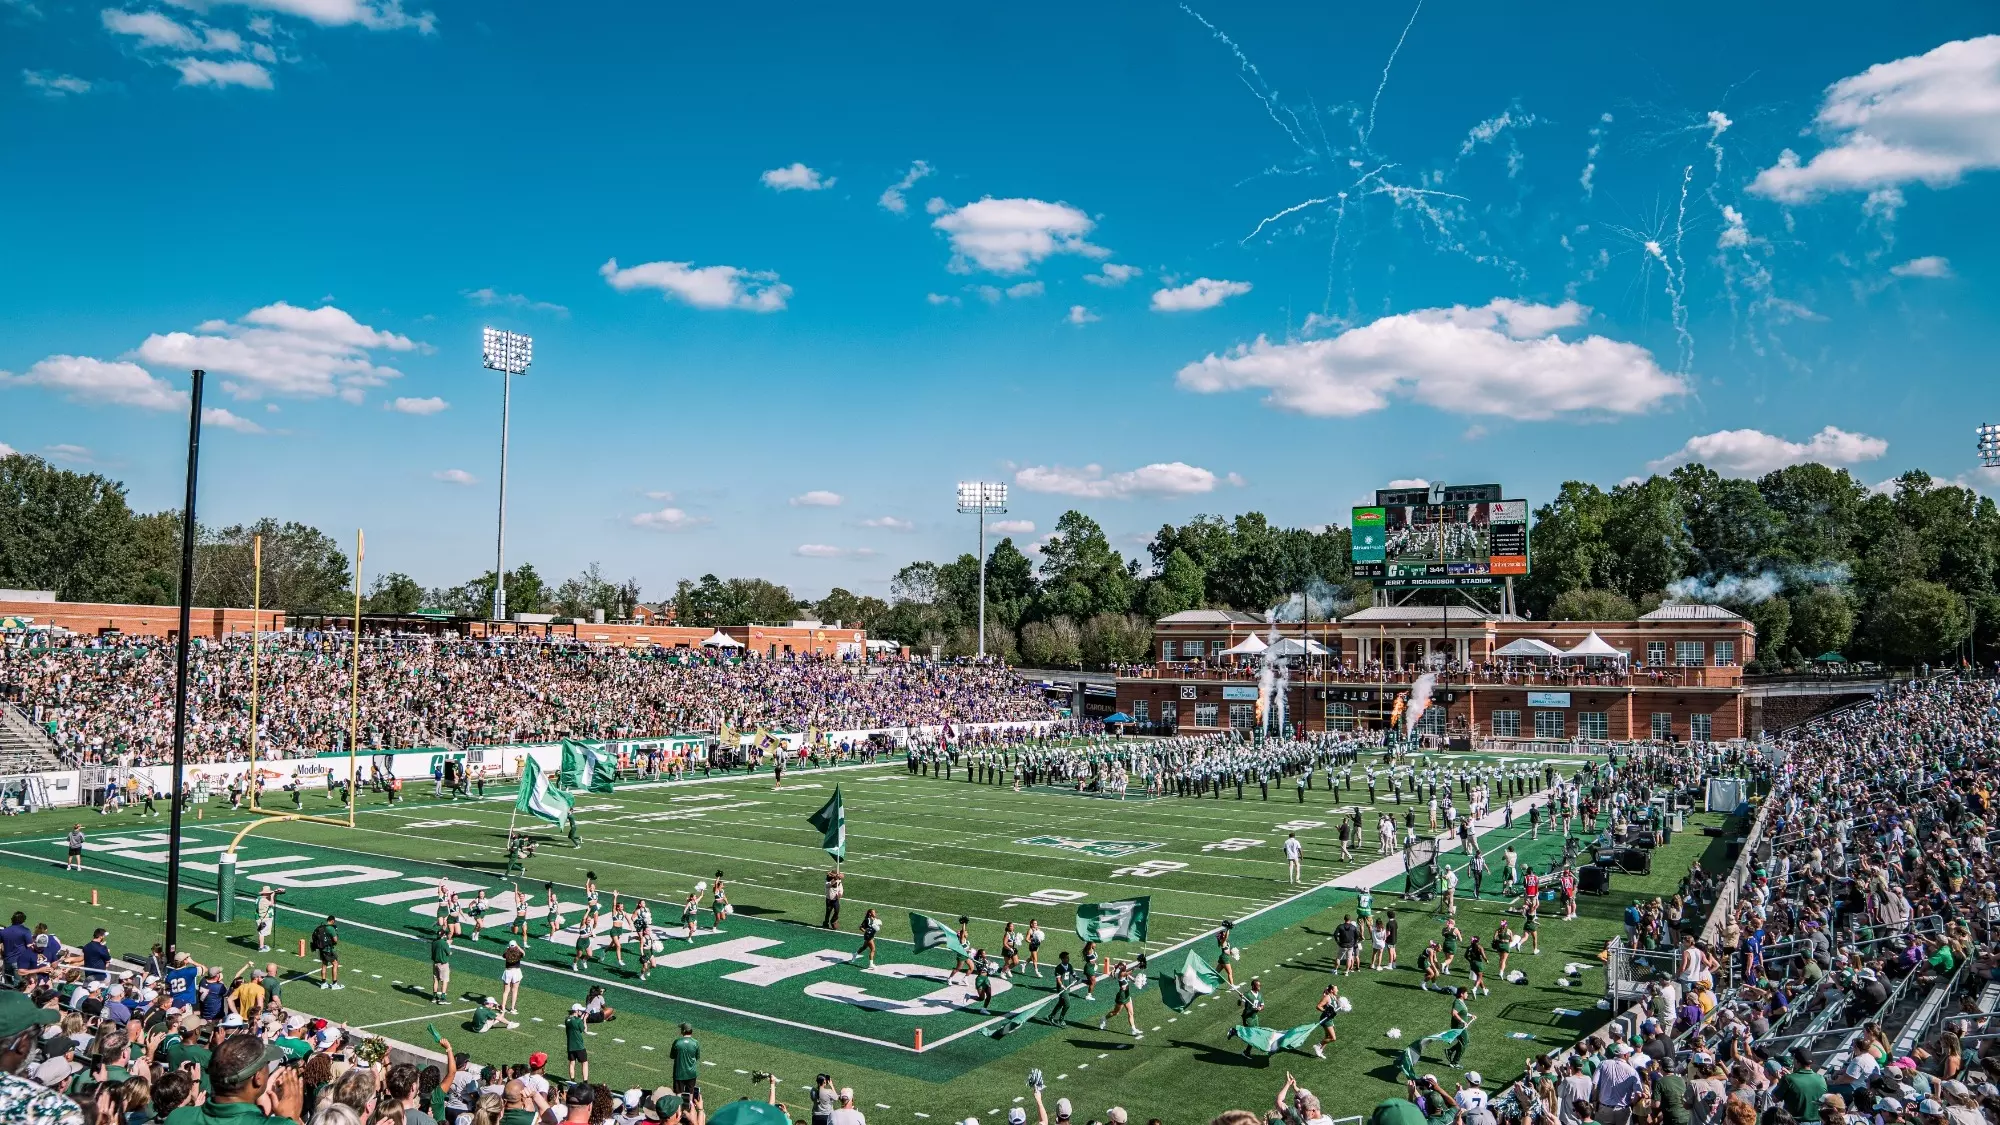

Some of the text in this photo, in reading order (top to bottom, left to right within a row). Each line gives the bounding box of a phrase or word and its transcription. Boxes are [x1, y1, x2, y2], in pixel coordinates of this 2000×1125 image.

[1183, 687, 1194, 698] 25
[297, 763, 324, 774] Modelo
[1110, 859, 1190, 877] 20
[1003, 888, 1089, 906] 10
[170, 977, 187, 993] 22
[1472, 1097, 1481, 1107] 7
